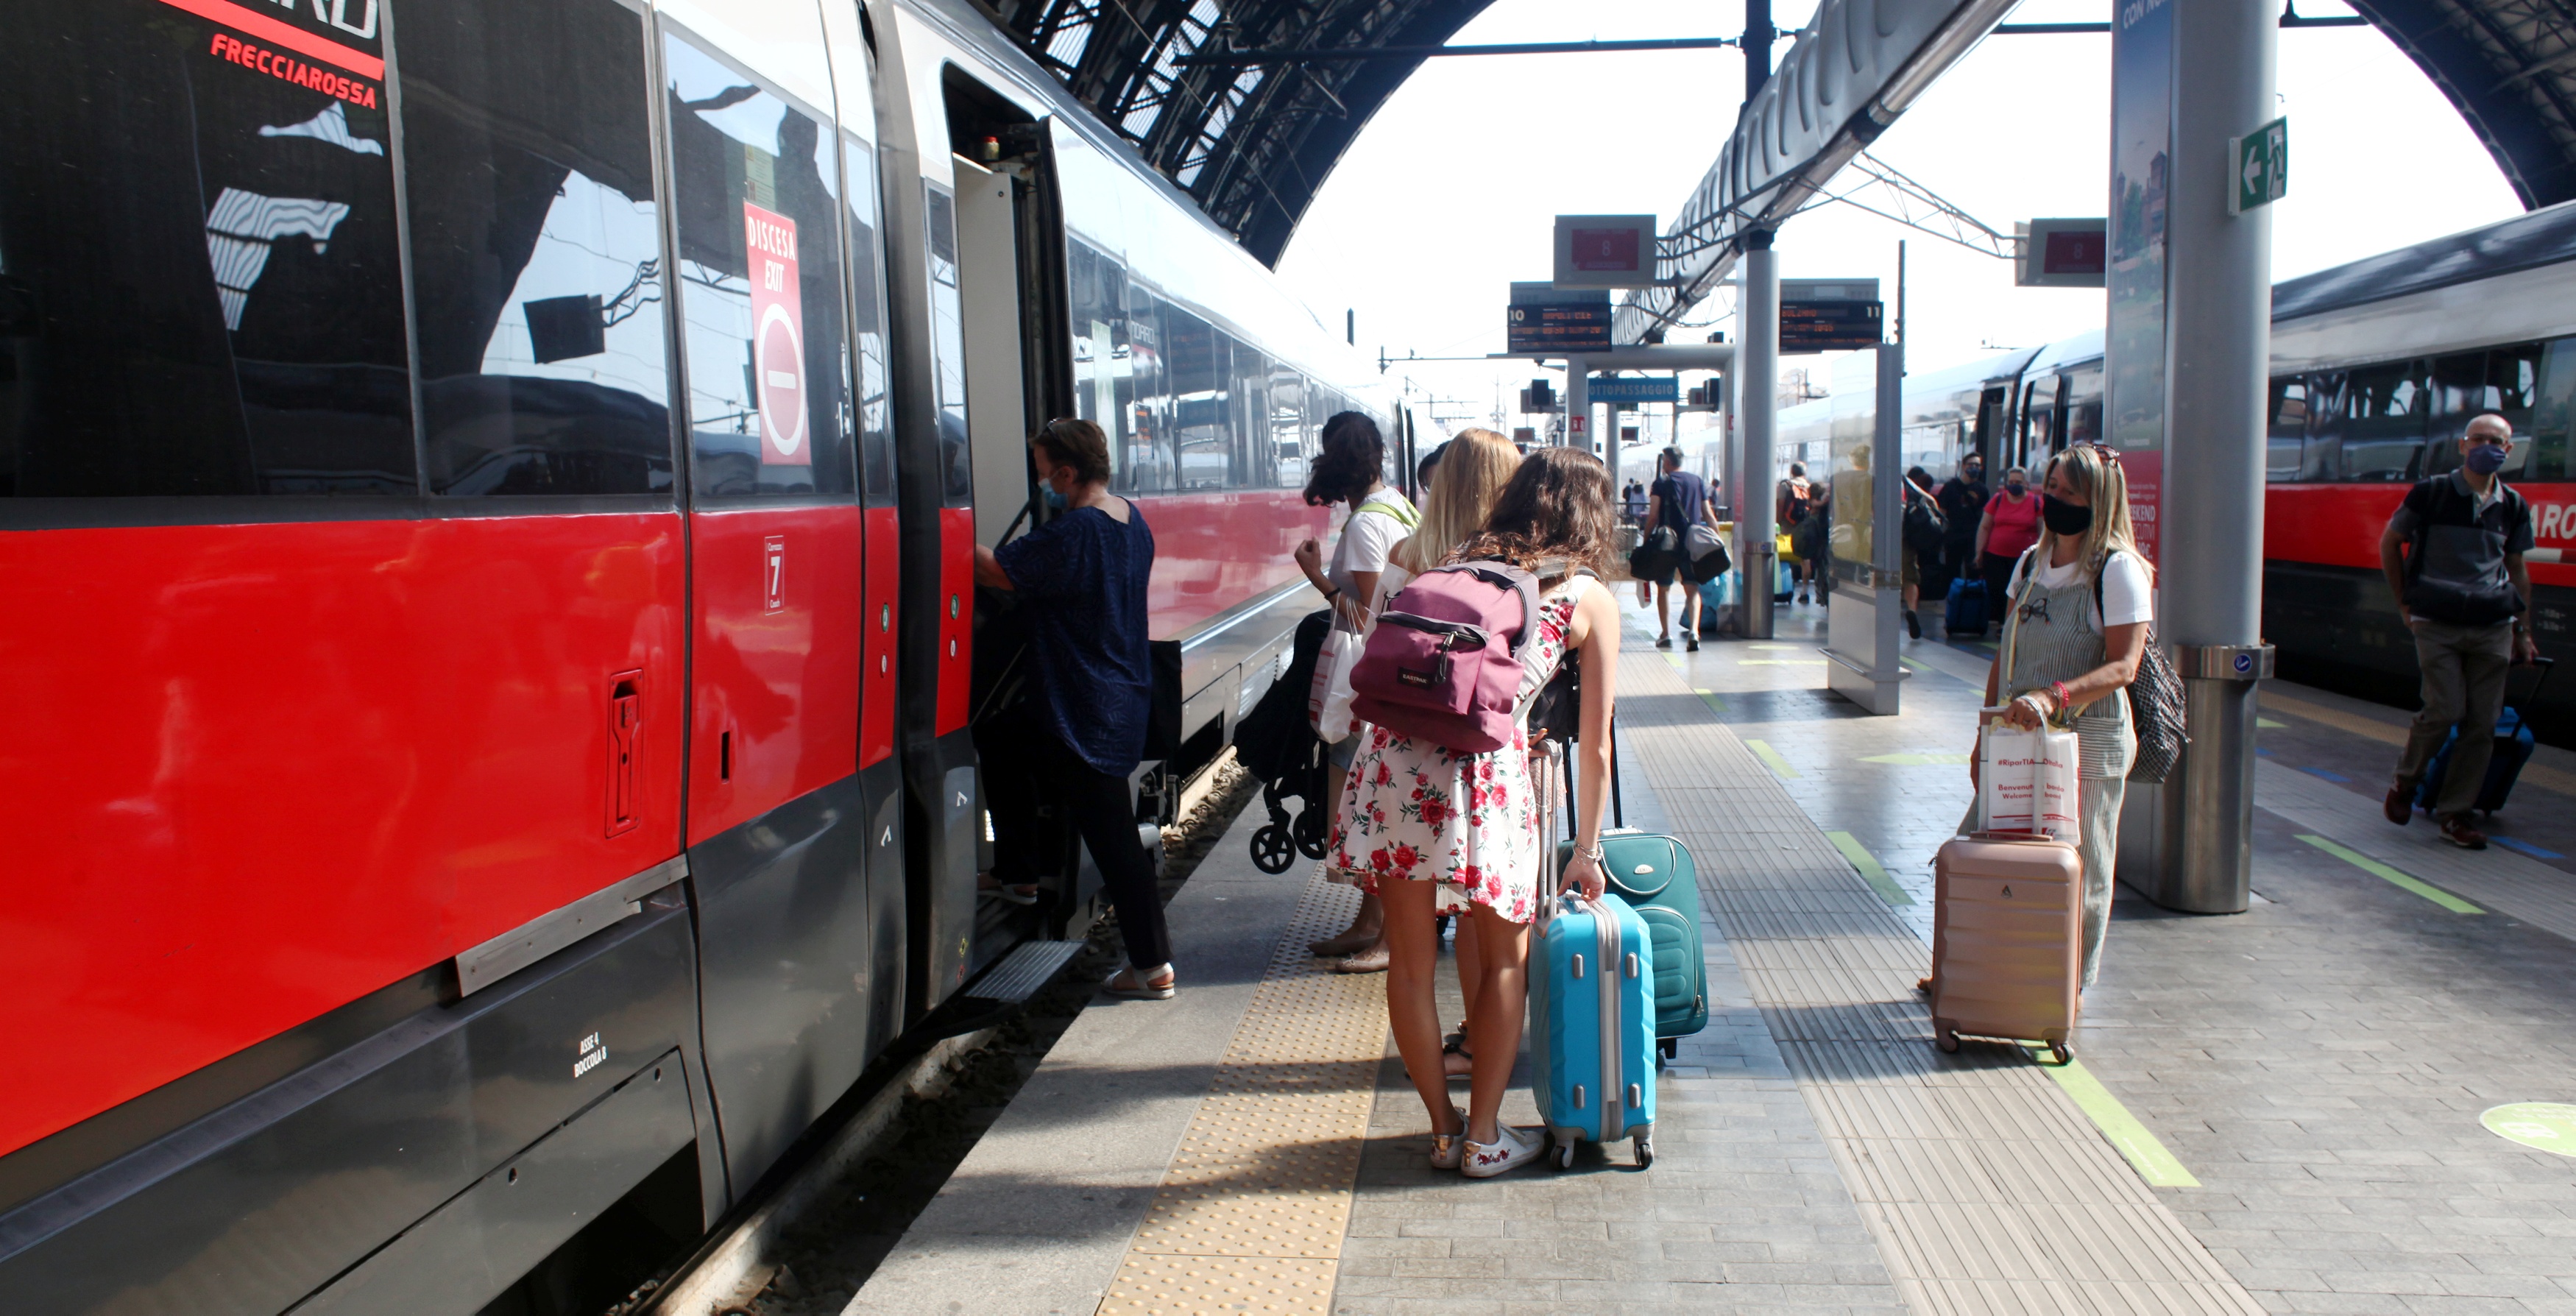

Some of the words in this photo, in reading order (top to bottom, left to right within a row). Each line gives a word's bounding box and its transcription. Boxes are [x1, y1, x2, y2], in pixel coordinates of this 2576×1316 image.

[210, 33, 376, 110] FRECCIAROSSA
[748, 216, 796, 261] DISCESA
[765, 259, 785, 293] EXIT
[1510, 309, 1525, 322] 10
[1866, 305, 1880, 318] 11
[1588, 383, 1674, 396] OTTOPASSAGGIO
[770, 556, 781, 595] 7
[1402, 673, 1428, 684] EASTPAK
[579, 1034, 595, 1055] ASSE
[594, 1031, 599, 1045] 4
[574, 1049, 602, 1078] BOCCOLA
[601, 1045, 607, 1061] 8
